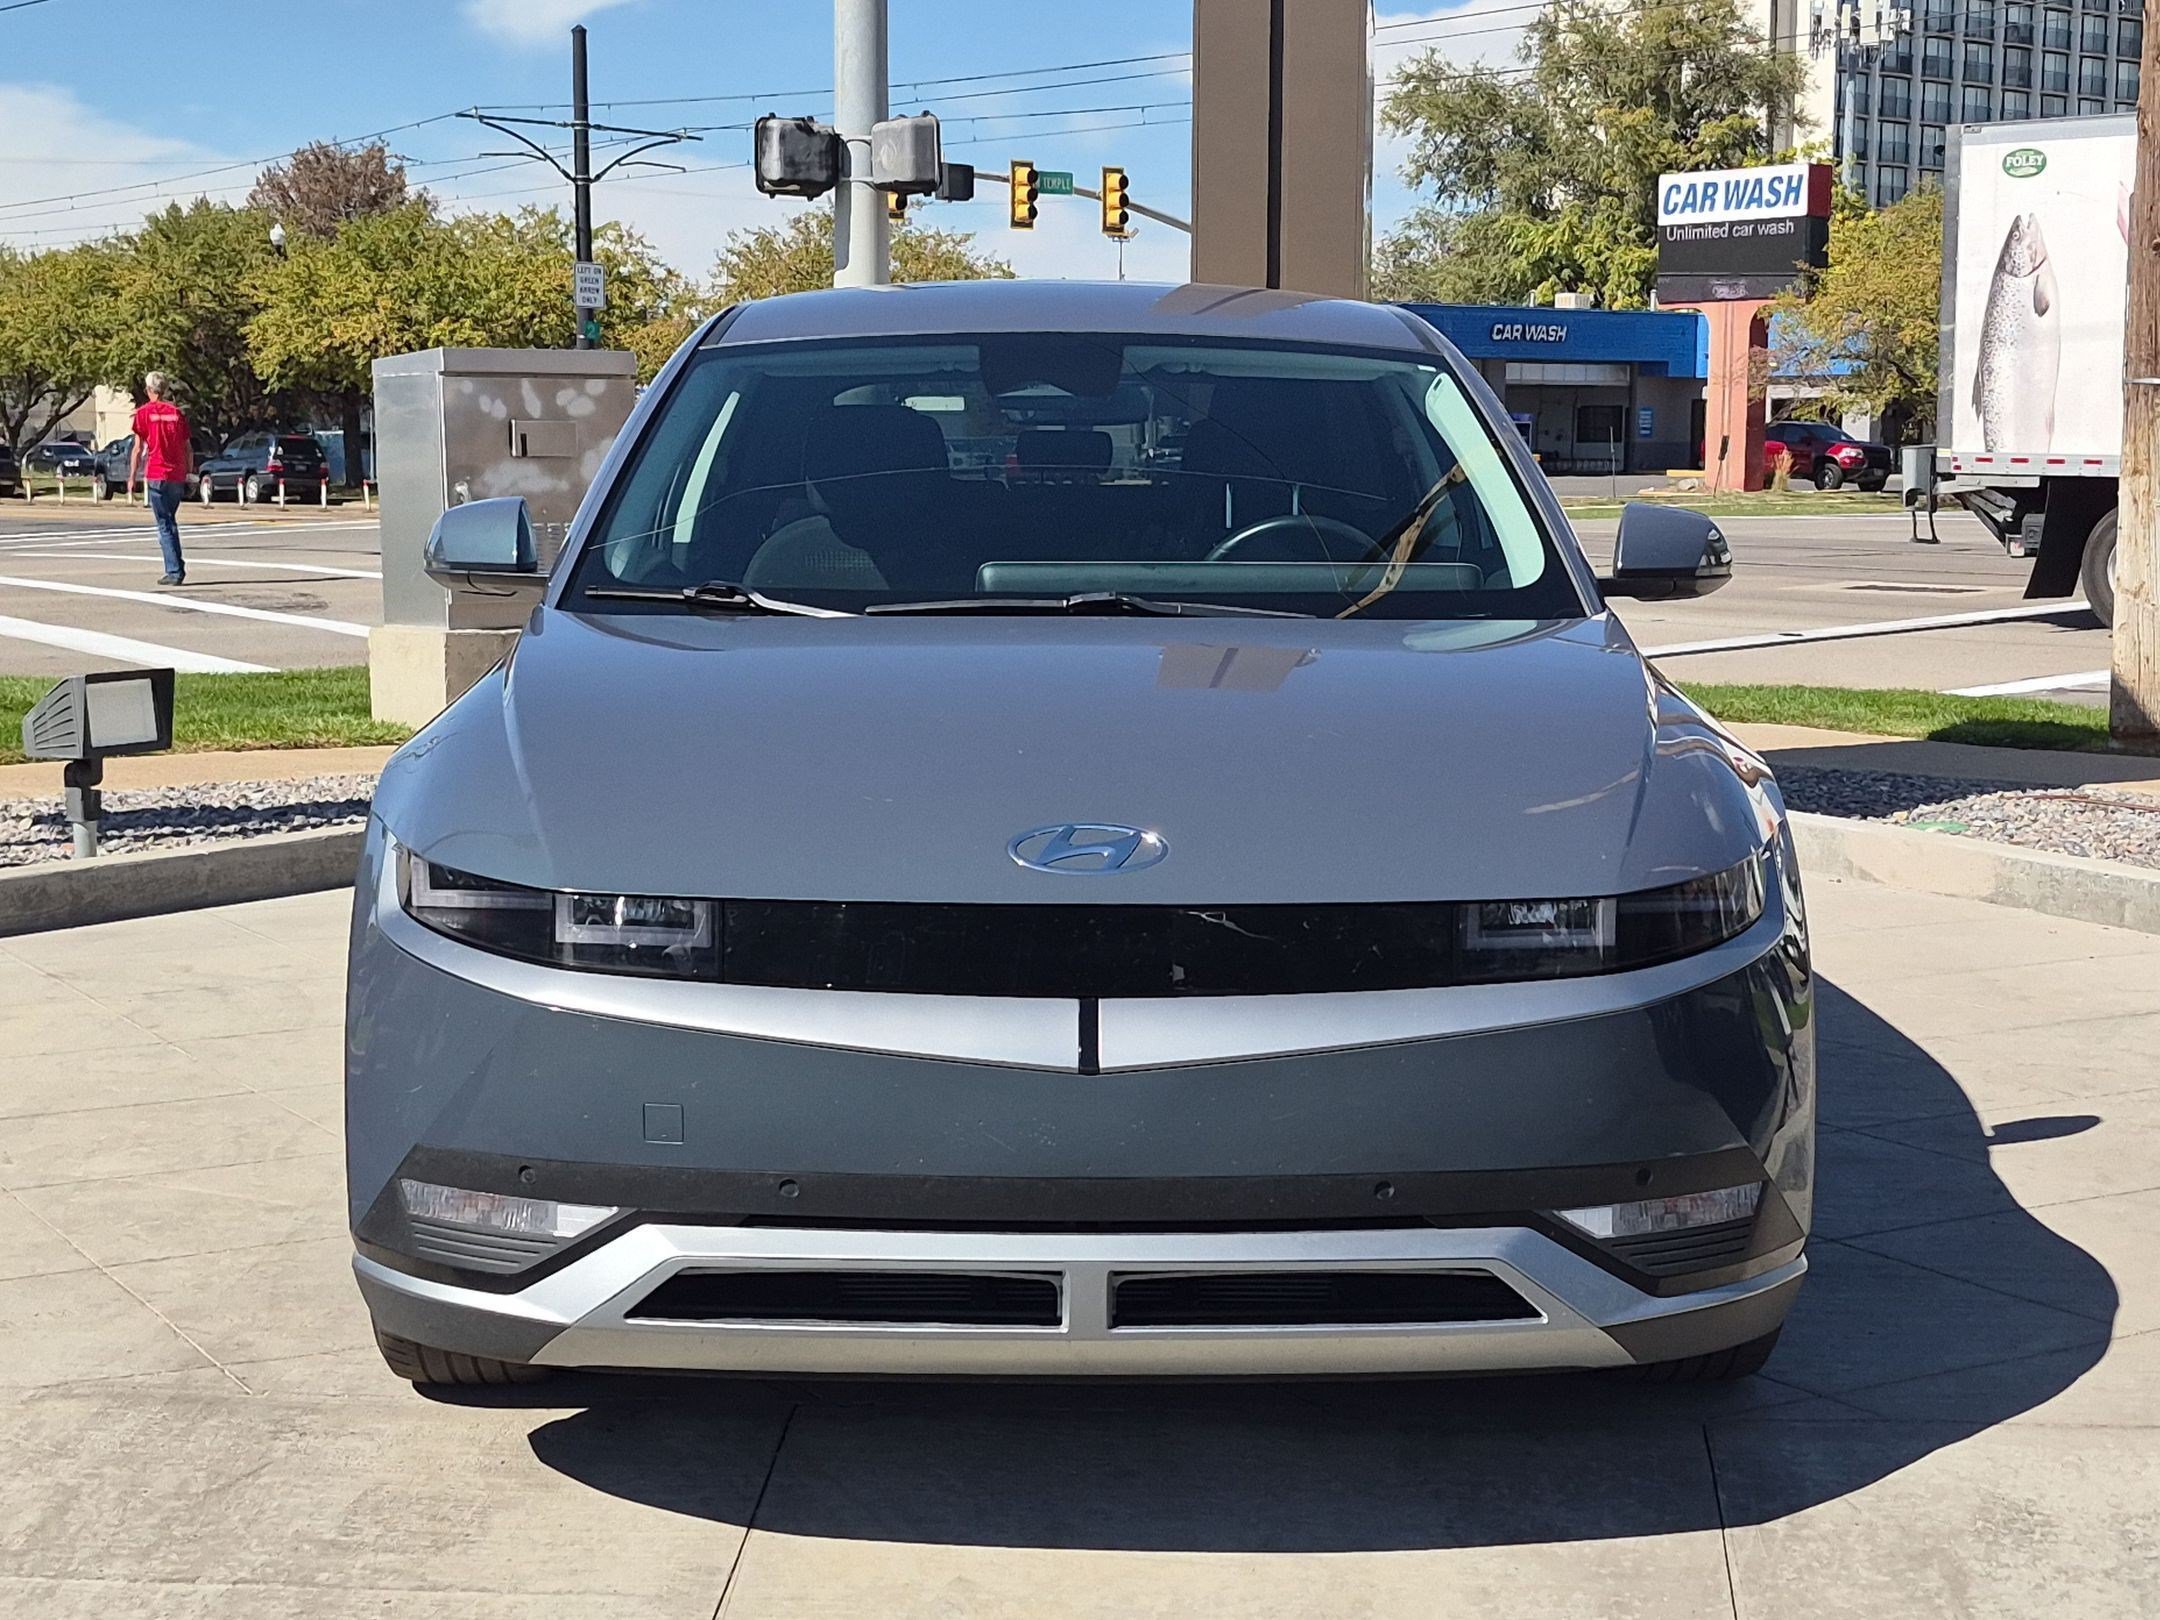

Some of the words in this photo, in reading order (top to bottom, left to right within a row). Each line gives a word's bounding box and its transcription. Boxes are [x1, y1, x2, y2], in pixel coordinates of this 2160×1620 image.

[2006, 154, 2044, 167] FOLEY
[1043, 176, 1070, 191] TEMPLE
[1663, 181, 1718, 215] CAR
[1724, 174, 1804, 211] WASH
[1666, 222, 1729, 241] Unlimited
[1732, 223, 1754, 237] car
[1758, 219, 1795, 235] wash
[577, 265, 591, 274] LEFT
[593, 266, 602, 275] ON
[580, 277, 599, 285] GREEN
[580, 286, 600, 294] ARROW
[581, 296, 597, 304] ONLY
[1492, 323, 1523, 341] CAR
[1525, 323, 1567, 342] WASH
